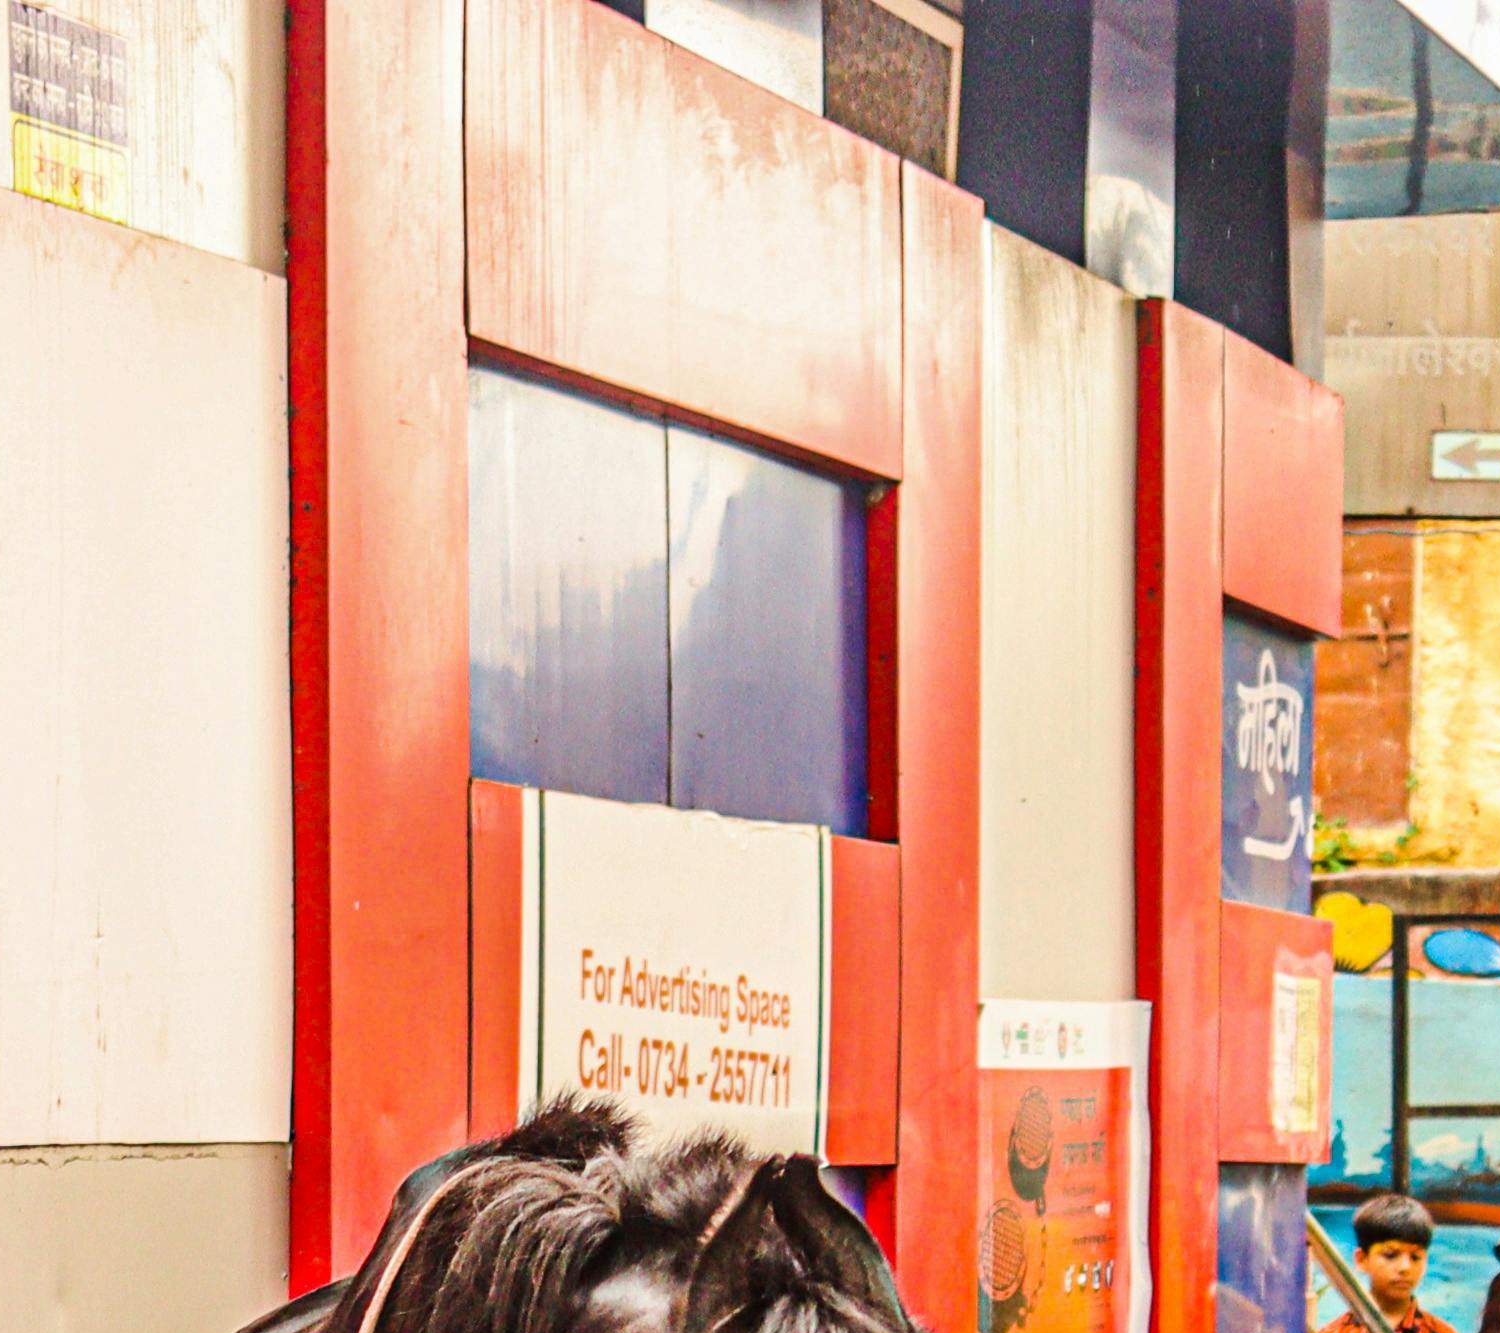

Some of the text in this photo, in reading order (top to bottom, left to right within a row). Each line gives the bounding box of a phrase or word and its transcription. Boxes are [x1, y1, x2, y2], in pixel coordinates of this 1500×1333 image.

[1237, 648, 1304, 795] महिला
[580, 949, 792, 1035] For Advertising Space
[638, 1040, 690, 1098] 0734
[710, 1046, 792, 1109] 2557711
